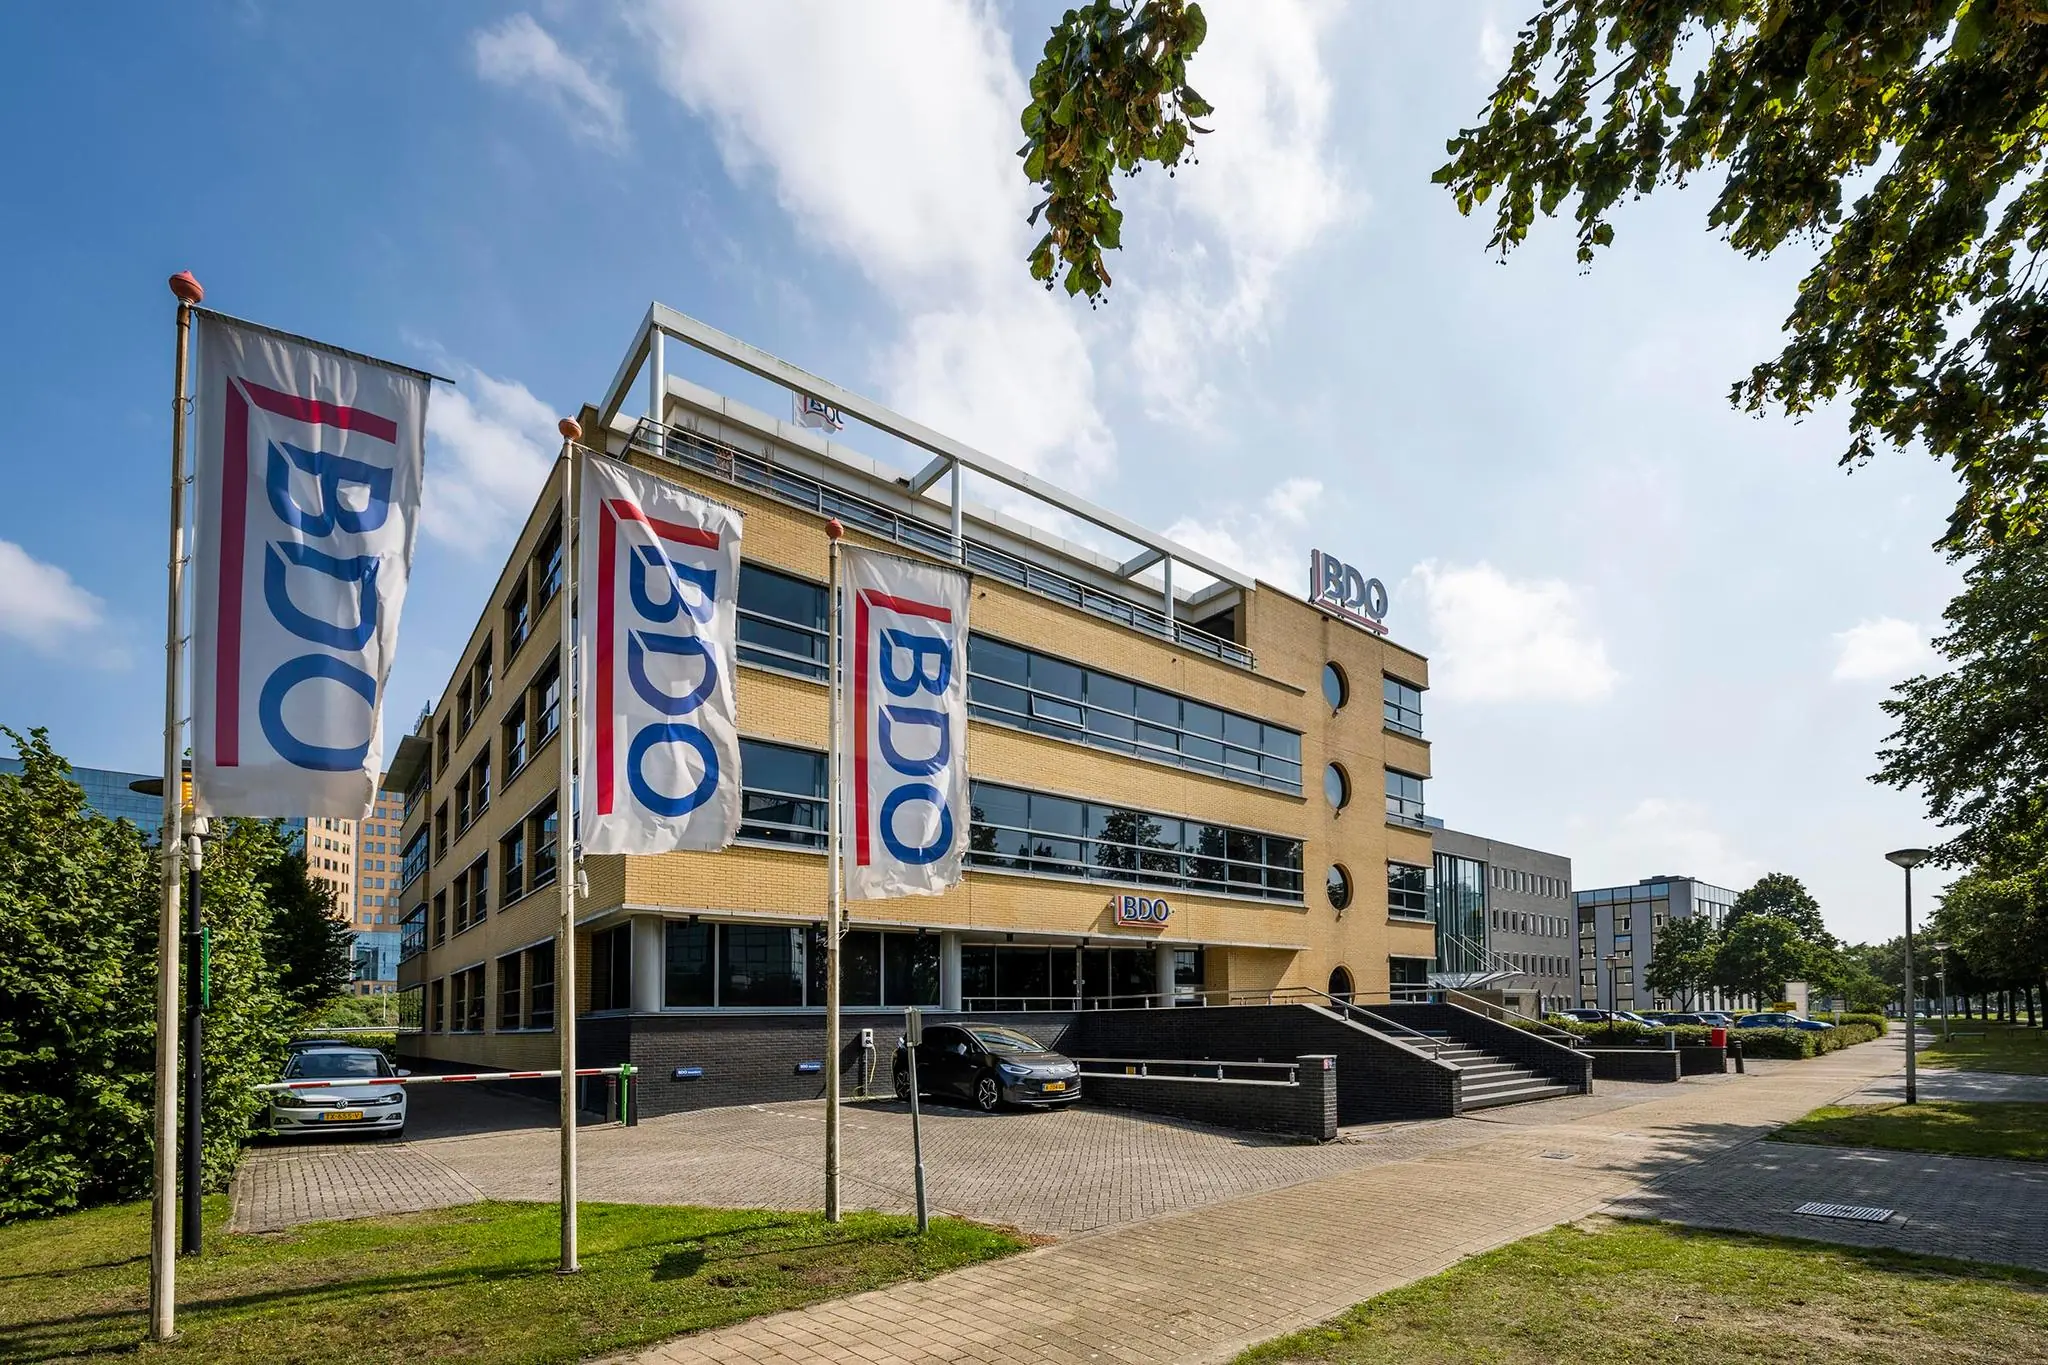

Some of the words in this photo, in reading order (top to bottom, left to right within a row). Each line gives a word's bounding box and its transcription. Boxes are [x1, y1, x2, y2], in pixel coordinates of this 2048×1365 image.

[259, 440, 393, 771] BDO
[627, 546, 719, 818] BDO
[1320, 553, 1388, 620] BDO
[878, 628, 954, 866] BDO
[1124, 895, 1169, 921] BDO
